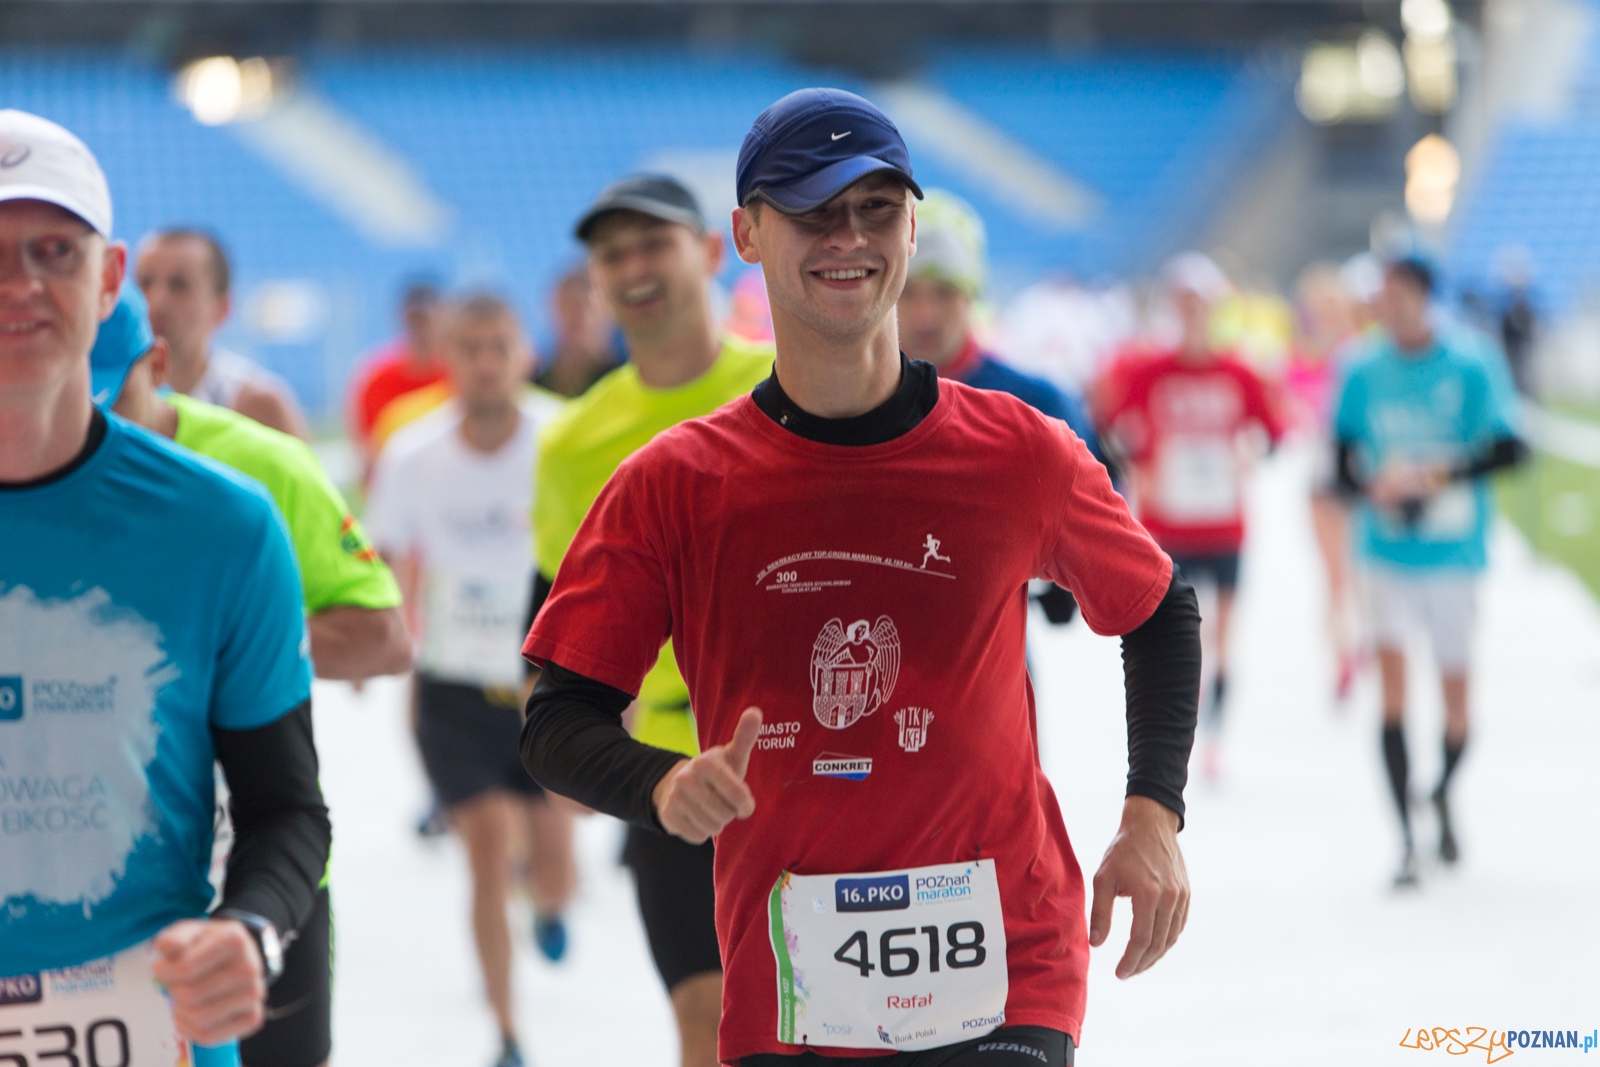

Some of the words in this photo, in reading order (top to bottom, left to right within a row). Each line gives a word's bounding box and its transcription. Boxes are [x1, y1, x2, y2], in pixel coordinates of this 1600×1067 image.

[776, 570, 798, 583] 300
[908, 706, 921, 726] TK
[759, 720, 801, 736] MIASTO
[757, 734, 796, 750] TORUŃ
[906, 727, 920, 749] KF
[814, 761, 872, 772] CONKRET
[0, 773, 106, 803] WAGA
[841, 887, 865, 903] 16.
[867, 885, 904, 902] PKO
[916, 884, 972, 901] maraton
[834, 920, 987, 978] 4618
[887, 993, 934, 1010] Rafał
[826, 1024, 853, 1036] posir
[894, 1032, 914, 1044] Bank
[915, 1027, 937, 1039] Polski
